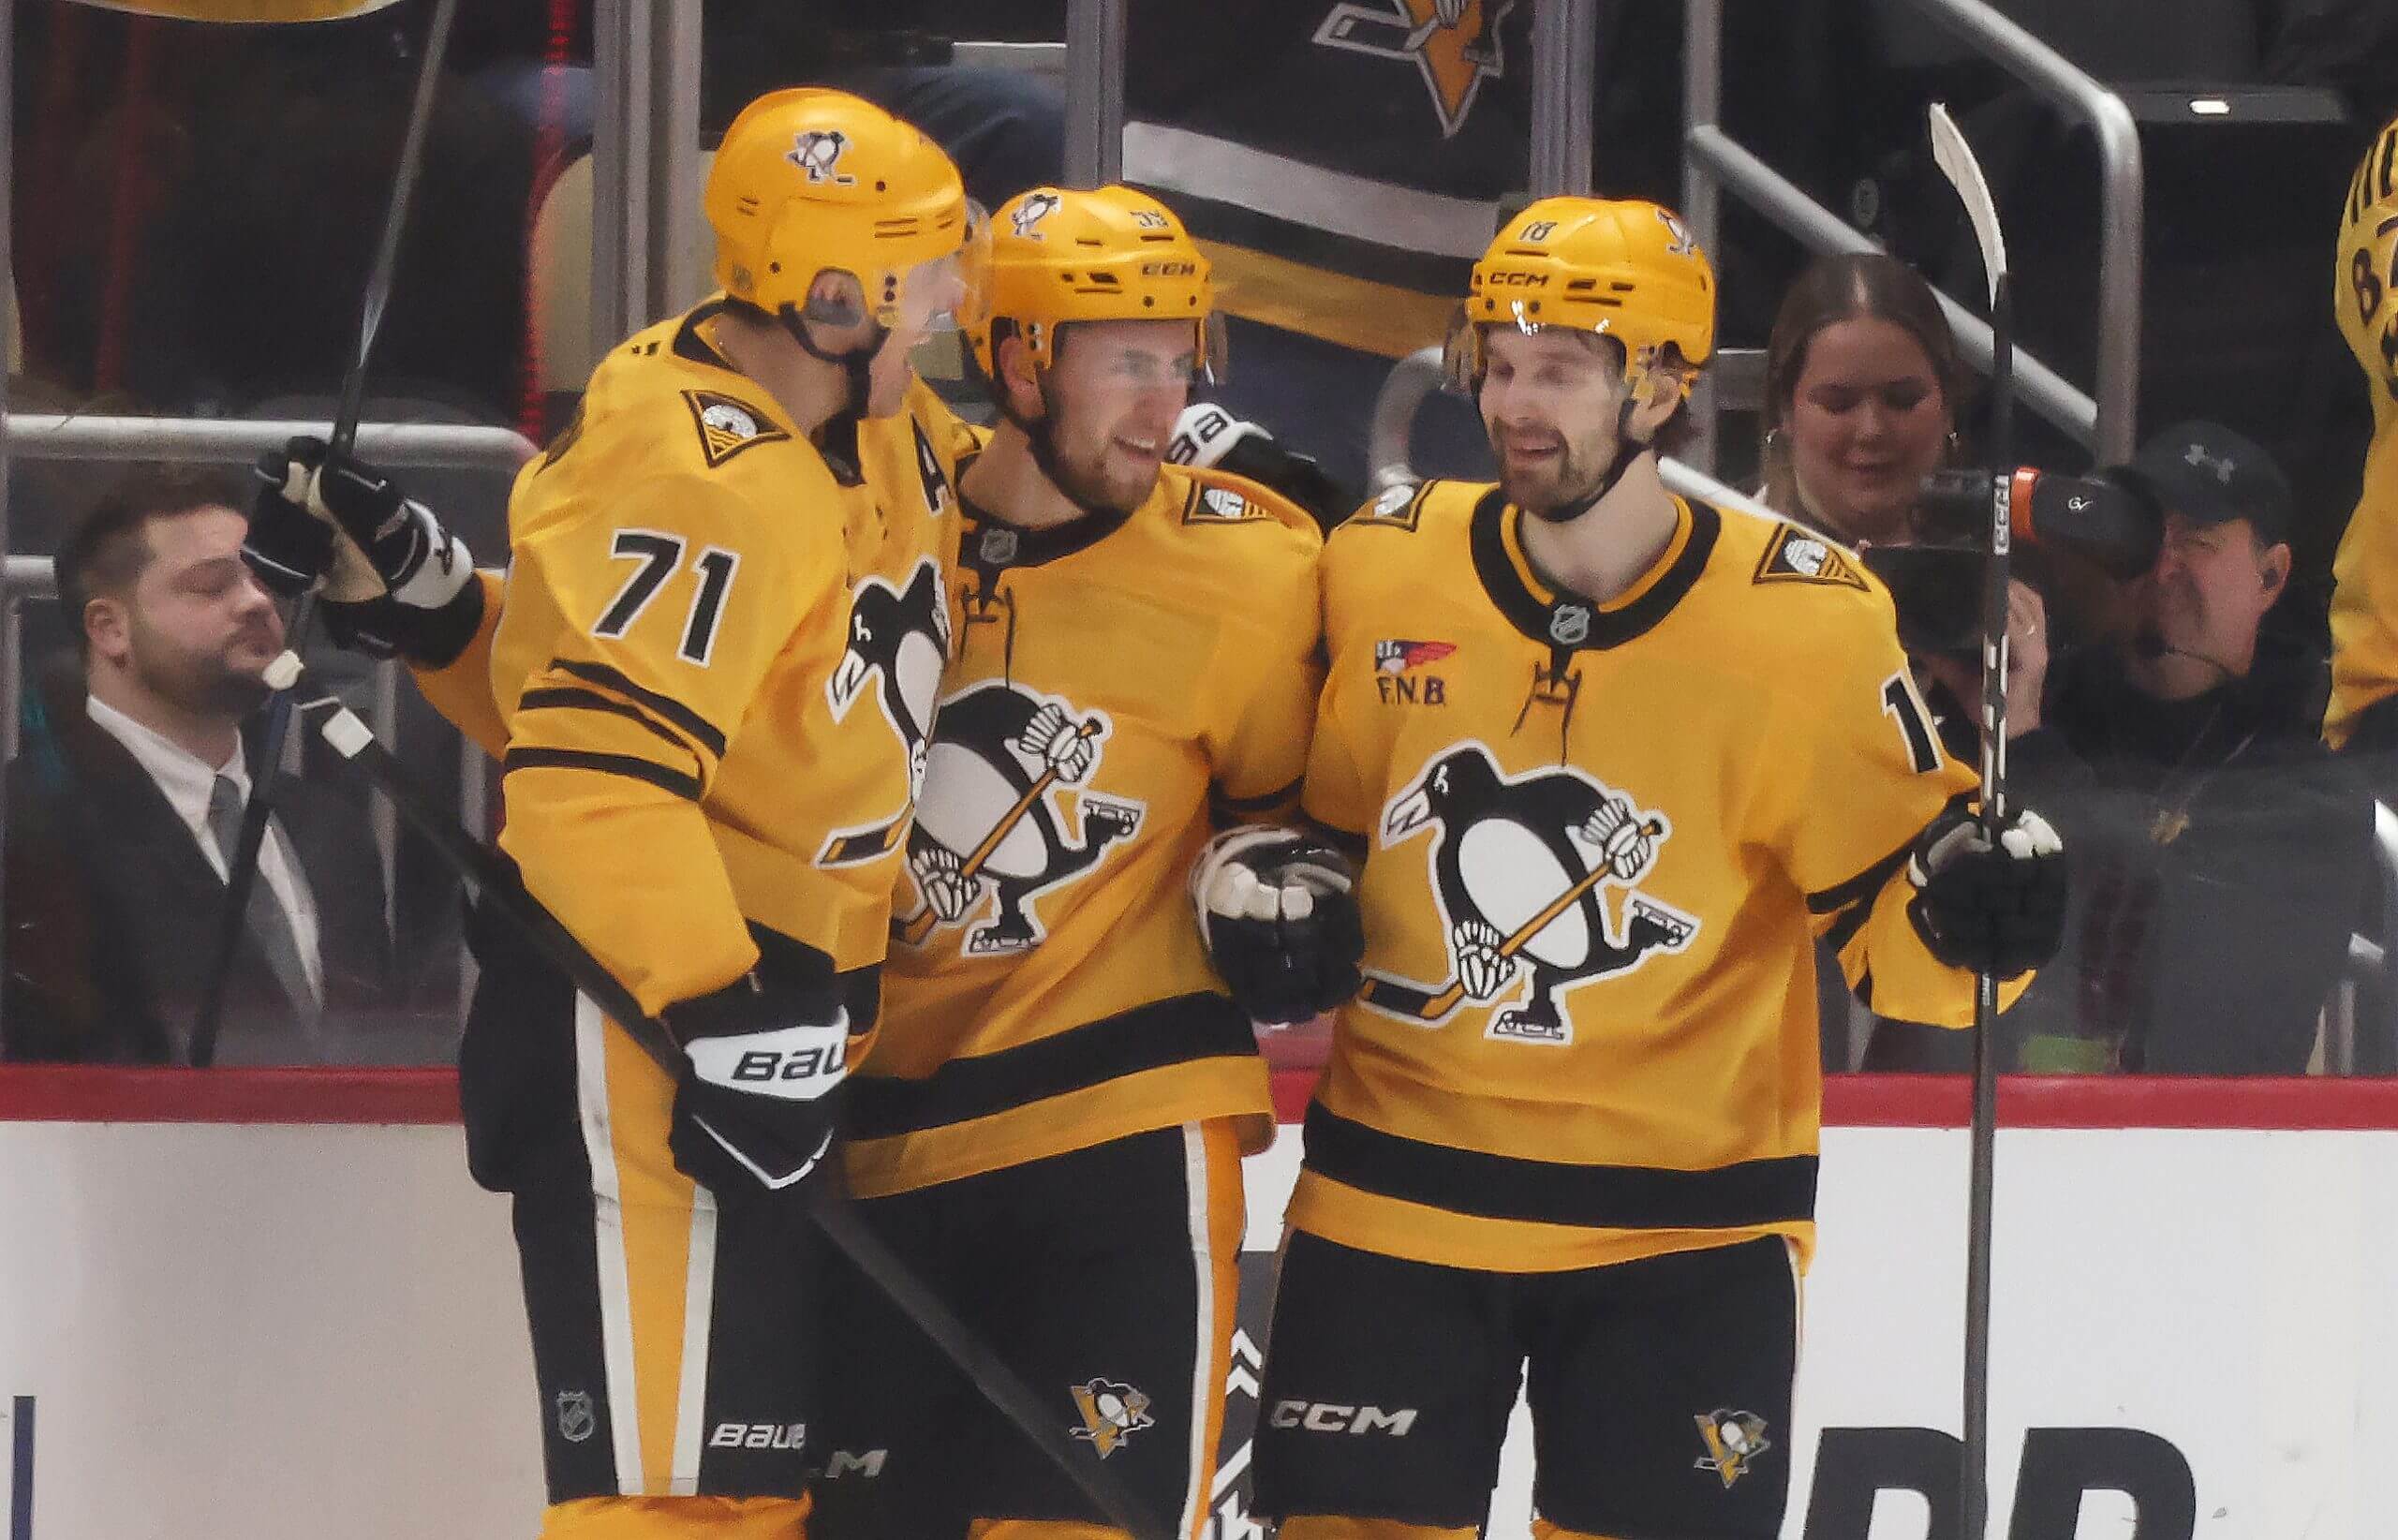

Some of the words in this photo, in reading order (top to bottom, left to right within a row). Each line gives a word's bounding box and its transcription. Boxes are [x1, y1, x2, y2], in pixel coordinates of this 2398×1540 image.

[1489, 273, 1550, 287] CCM
[909, 411, 955, 514] A
[588, 527, 743, 669] 71
[1271, 1399, 1419, 1437] CCM
